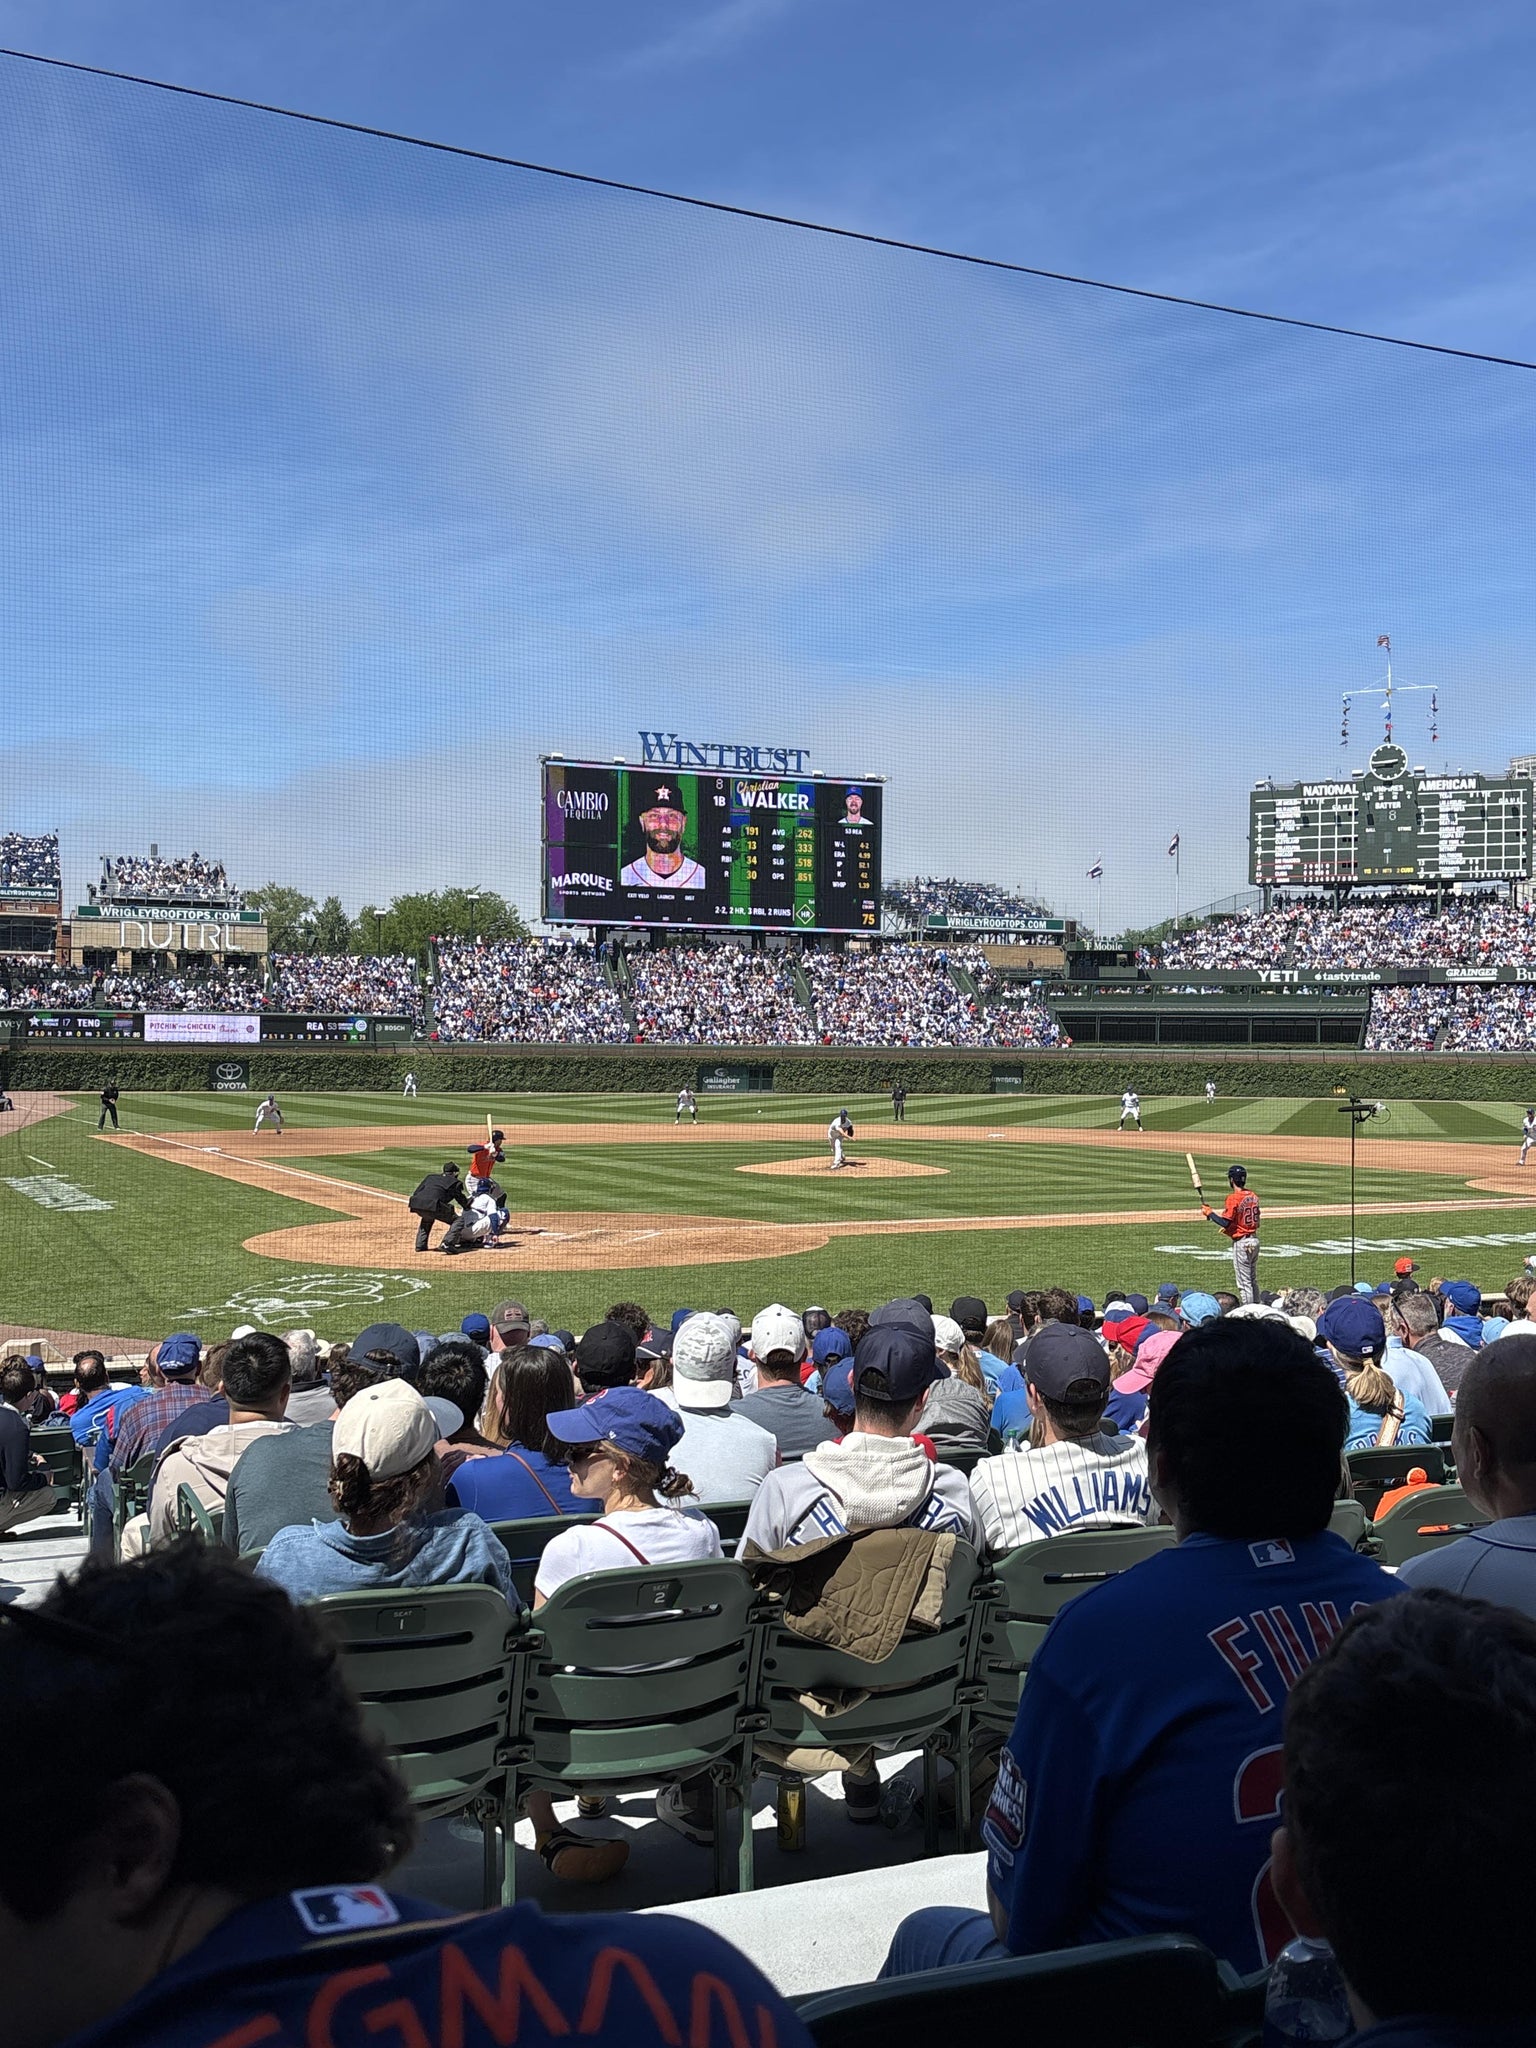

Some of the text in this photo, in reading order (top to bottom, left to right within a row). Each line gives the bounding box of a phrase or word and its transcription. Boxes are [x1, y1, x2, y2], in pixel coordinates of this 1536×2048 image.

[638, 731, 810, 773] WINTRUST
[715, 779, 724, 789] 8
[737, 781, 779, 794] Christian
[1417, 778, 1476, 792] AMERICAN
[1303, 784, 1359, 797] NATIONAL
[557, 790, 609, 811] CAMBIO
[713, 796, 726, 807] 1B
[740, 792, 809, 810] WALKER
[564, 808, 602, 820] TEQUILA
[1389, 810, 1396, 821] 8
[745, 826, 759, 836] 191
[795, 830, 813, 839] .262
[747, 841, 757, 850] 13
[795, 844, 813, 853] .333
[746, 856, 757, 865] 34
[772, 858, 813, 868] SLG .518
[746, 870, 757, 880] 30
[795, 873, 813, 882] .851
[551, 872, 614, 891] MARQUEE
[100, 906, 240, 921] WRIGLEYROOFTOPS.COM
[714, 906, 728, 915] 2-2,
[734, 907, 746, 915] HR,
[862, 914, 875, 925] 75
[947, 917, 1047, 929] WRIGLEYROOFTOPS.COM
[1094, 940, 1123, 951] Mobile
[1257, 970, 1299, 982] YETI
[1323, 972, 1381, 982] tastytrade
[1446, 968, 1499, 977] GRAINGER
[77, 1019, 100, 1027] TENG
[306, 1022, 324, 1030] REA
[702, 1077, 740, 1085] Gallagher
[1021, 1470, 1151, 1539] WILLIAMS
[654, 1591, 665, 1604] 2
[393, 1610, 412, 1618] SEAT
